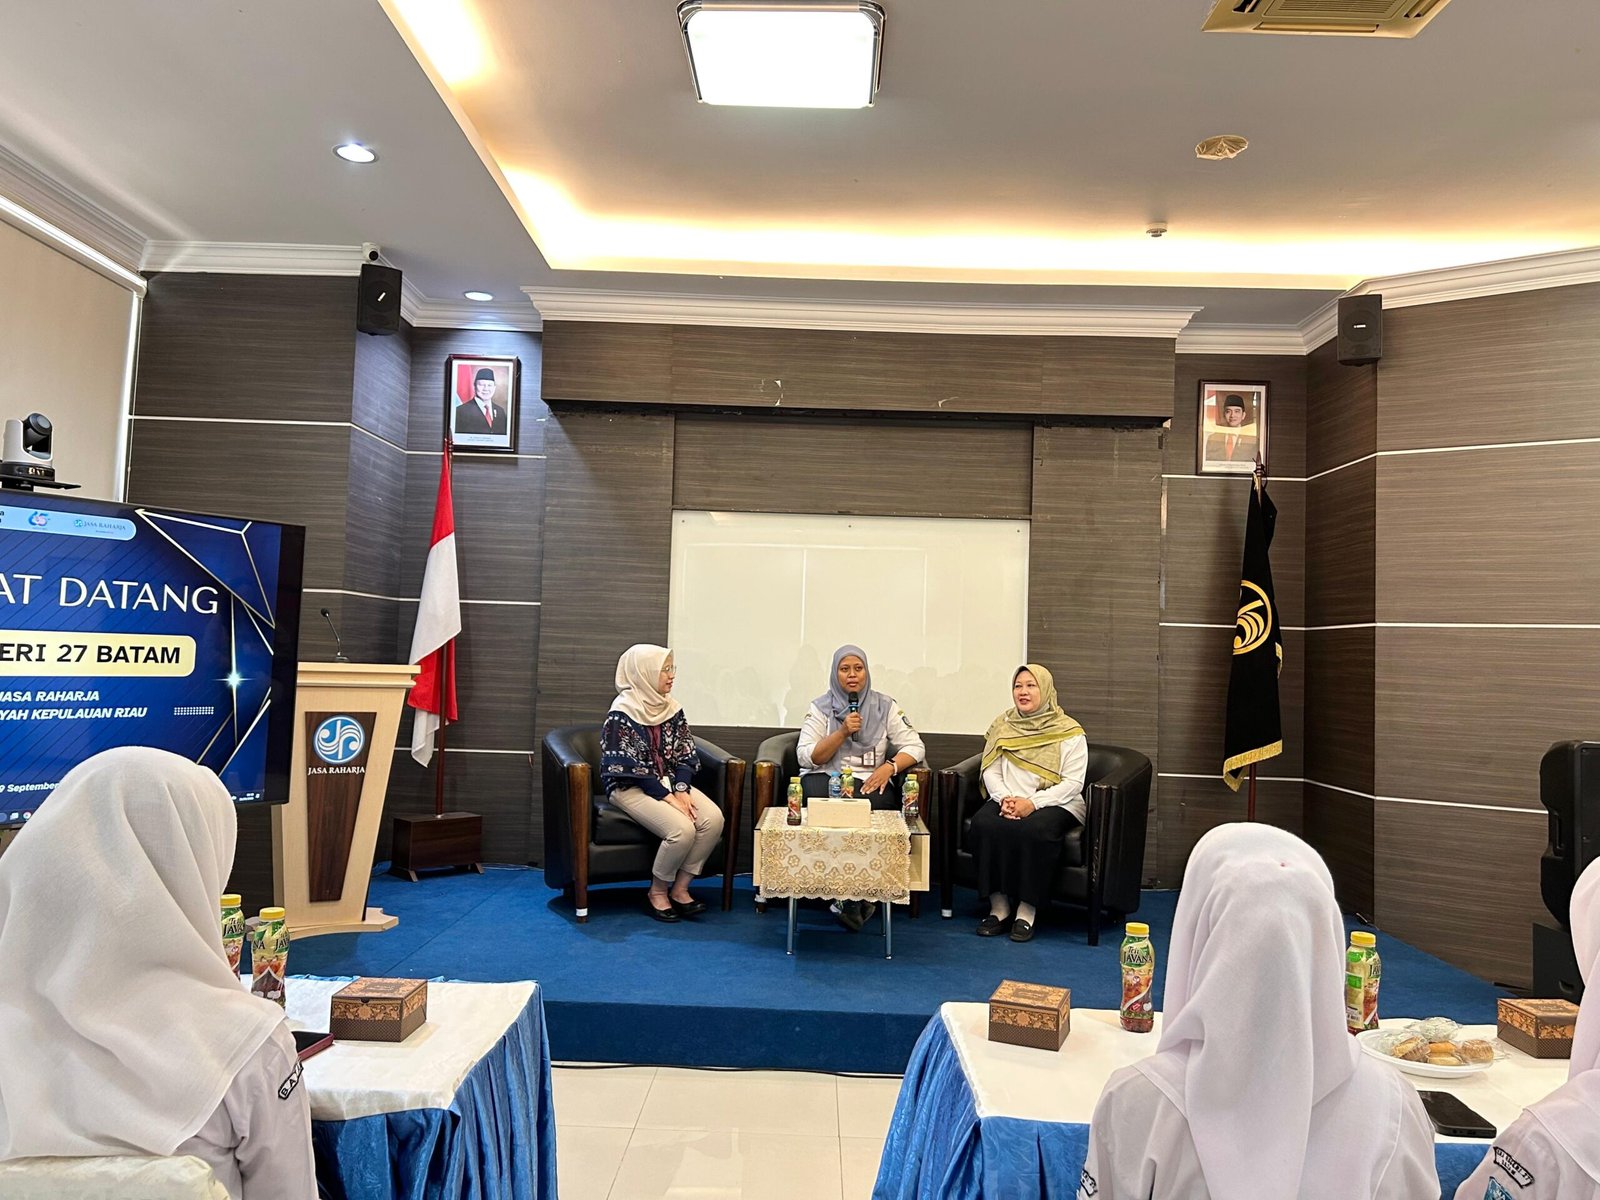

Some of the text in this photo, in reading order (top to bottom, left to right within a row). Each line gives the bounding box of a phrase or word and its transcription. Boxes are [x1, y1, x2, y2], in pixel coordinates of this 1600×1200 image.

[59, 577, 219, 614] DATANG
[0, 643, 181, 664] ERI 27 BATAM
[35, 690, 100, 702] RAHARJA
[31, 708, 113, 720] KEPULAUAN
[114, 707, 148, 718] RIAU
[307, 766, 365, 776] JASA RAHARJA
[7, 782, 60, 793] September
[1122, 951, 1153, 964] JAVANA
